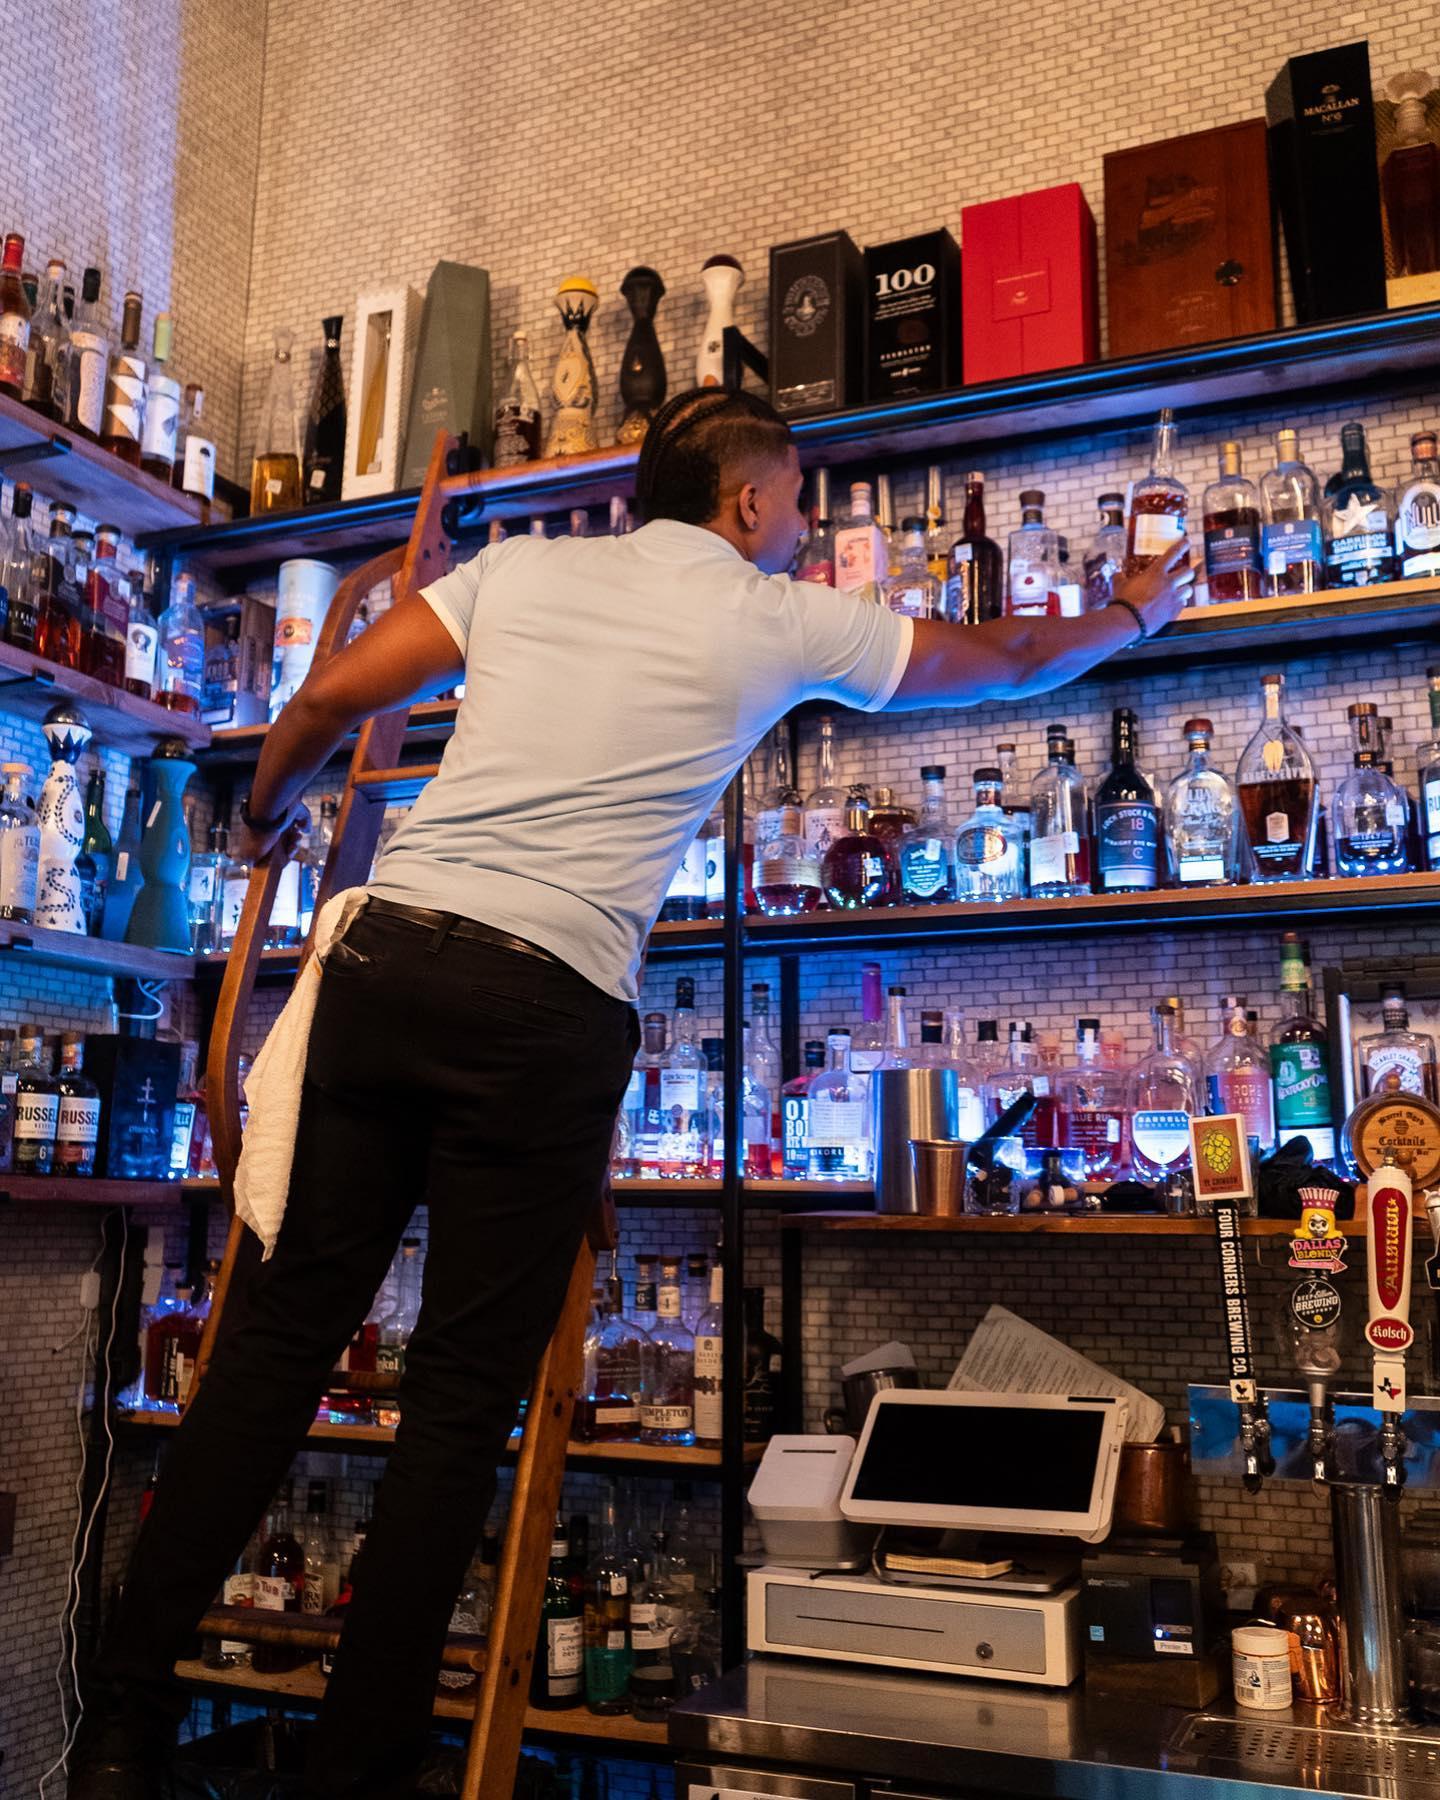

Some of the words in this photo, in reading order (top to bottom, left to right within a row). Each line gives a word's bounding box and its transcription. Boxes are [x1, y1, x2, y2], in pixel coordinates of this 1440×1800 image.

[1303, 96, 1360, 117] MACALLAN
[875, 264, 936, 297] 100
[1379, 1136, 1426, 1146] Cocktails
[1218, 1208, 1234, 1238] FOUR
[1295, 1239, 1341, 1251] DALLAS
[1297, 1249, 1338, 1259] BLONDE
[1221, 1241, 1239, 1295] CORNERS
[1226, 1298, 1245, 1354] BREWING
[1372, 1325, 1407, 1342] Kolsch
[1232, 1357, 1247, 1376] CO.
